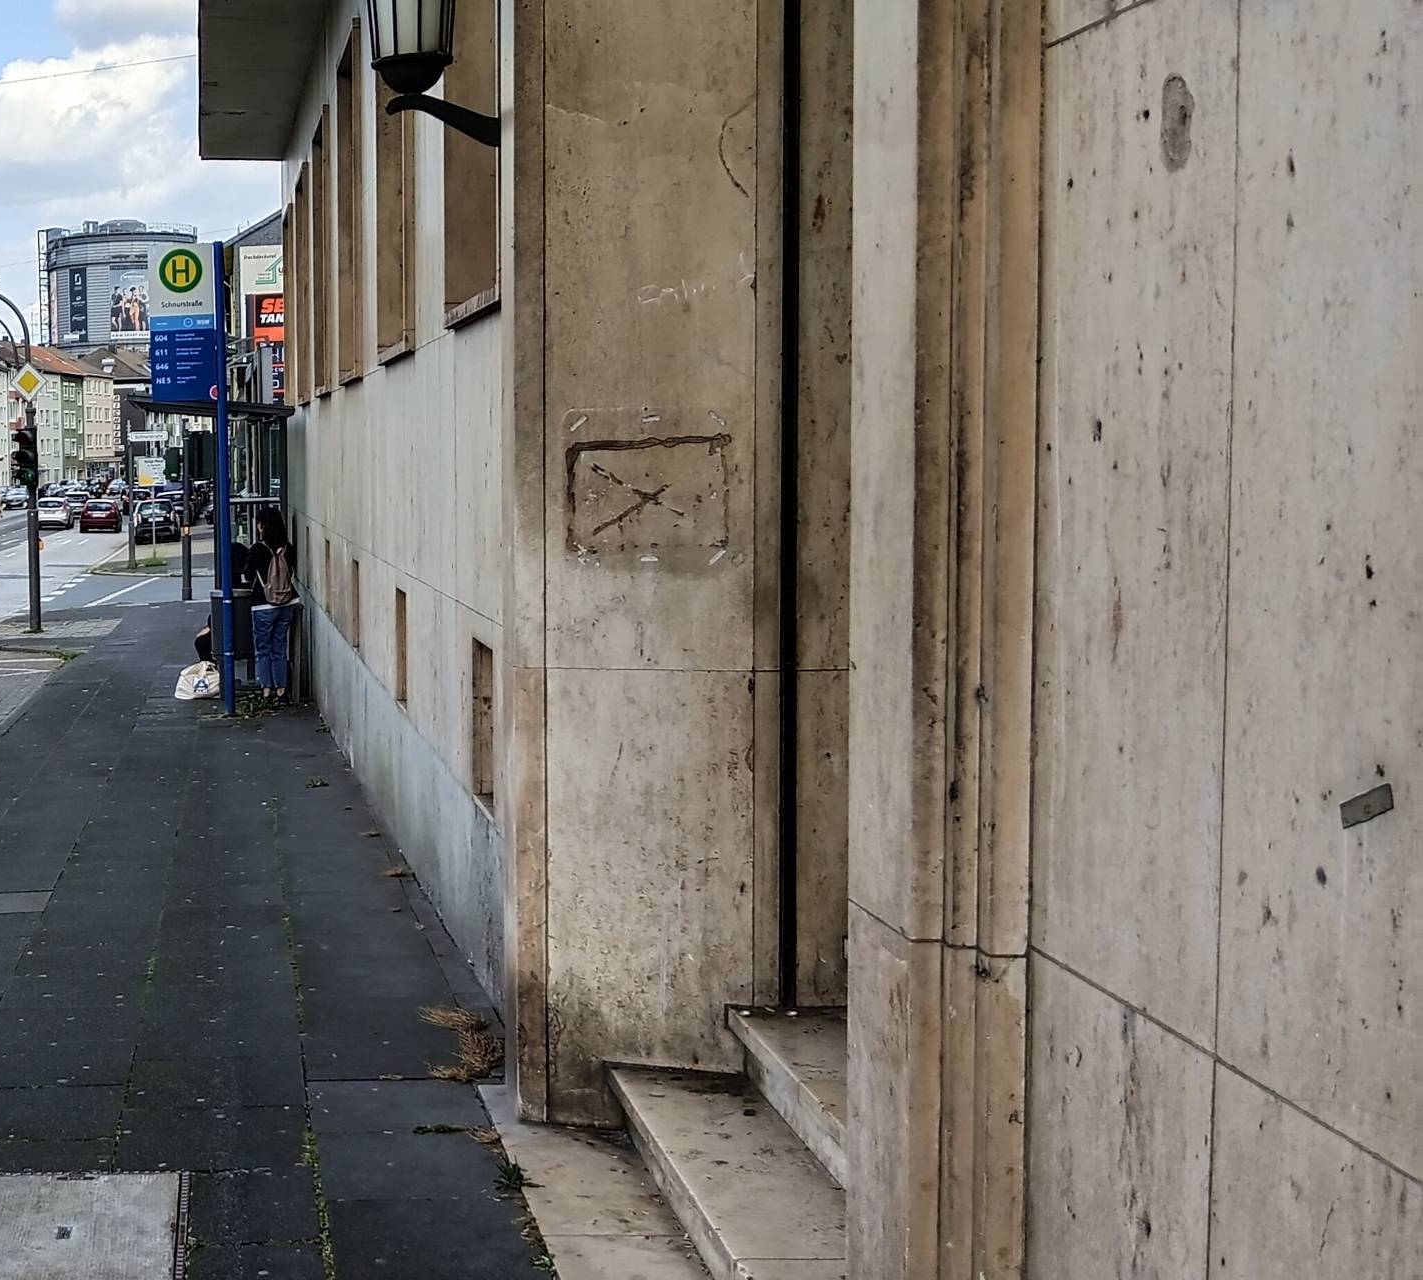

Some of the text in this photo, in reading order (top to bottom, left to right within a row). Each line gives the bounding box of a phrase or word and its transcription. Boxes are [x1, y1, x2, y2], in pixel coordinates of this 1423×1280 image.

[161, 300, 203, 309] Schnurstraße
[154, 334, 168, 342] 604
[155, 348, 168, 356] 611
[155, 362, 169, 370] 646
